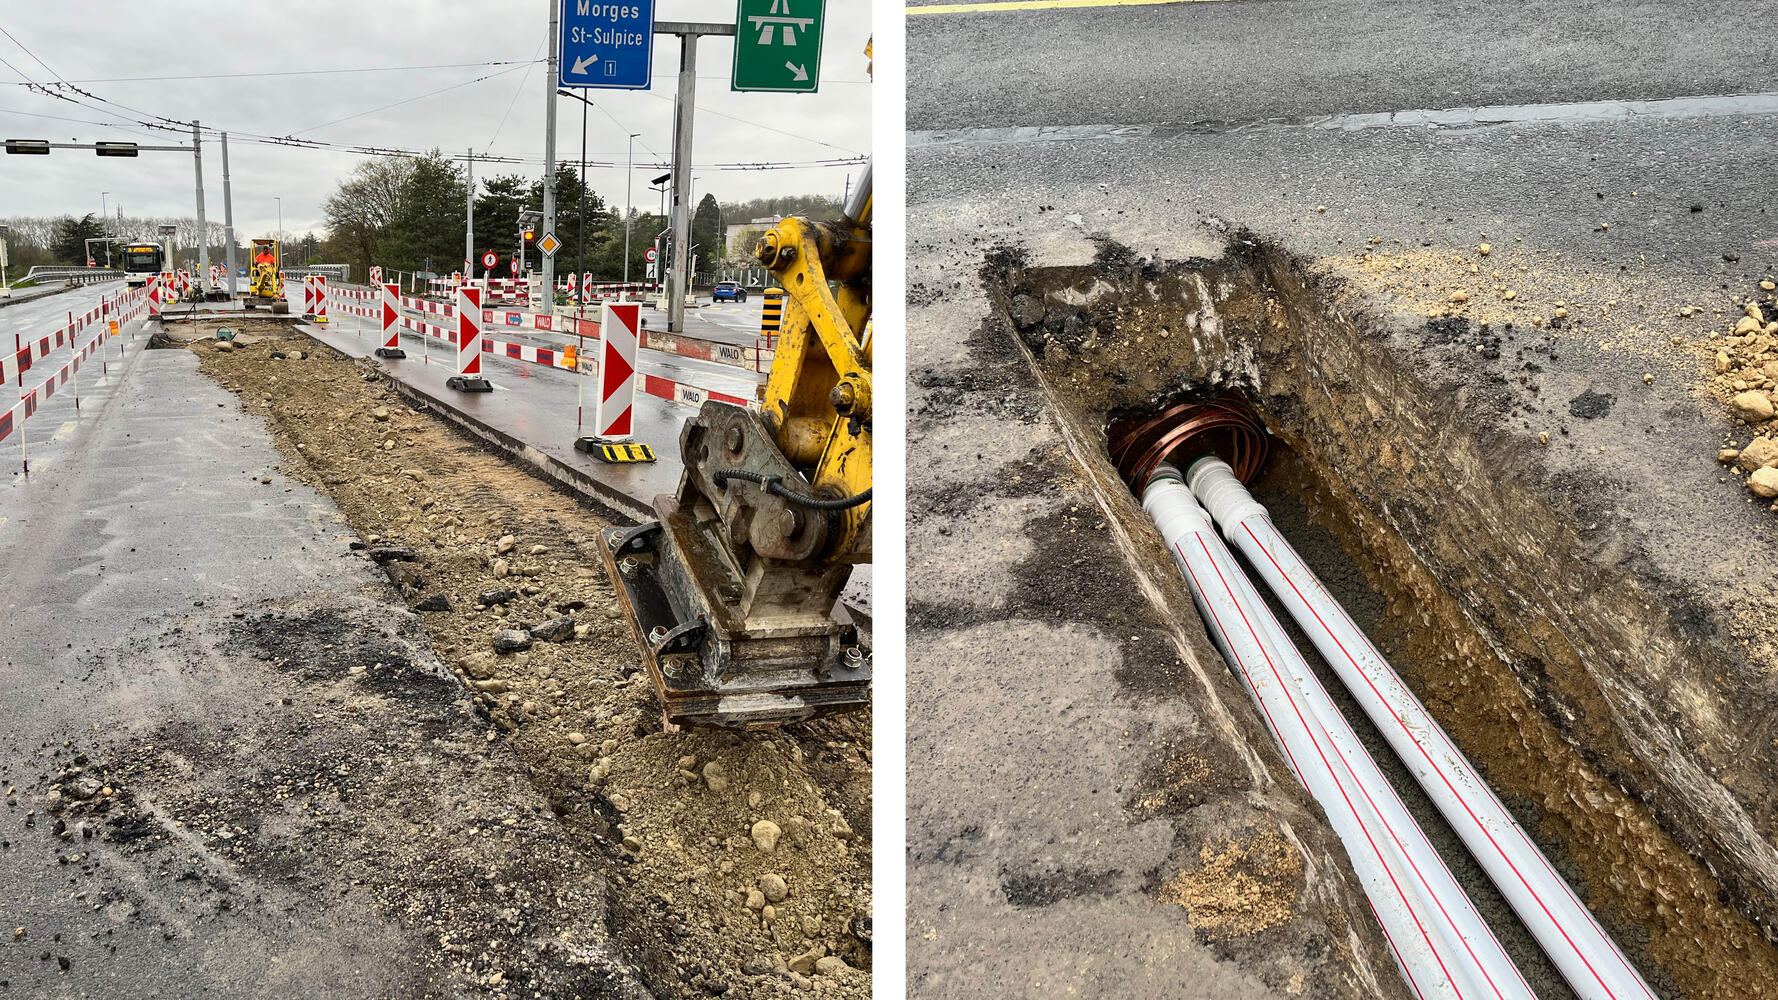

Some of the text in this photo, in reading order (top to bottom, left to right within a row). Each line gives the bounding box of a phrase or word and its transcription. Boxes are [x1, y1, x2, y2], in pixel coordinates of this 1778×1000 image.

[577, 0, 639, 22] Morges
[572, 27, 642, 49] St-Sulpice
[609, 63, 613, 75] 1
[537, 316, 551, 329] WALO
[719, 346, 739, 360] WALO
[682, 389, 700, 403] WALO
